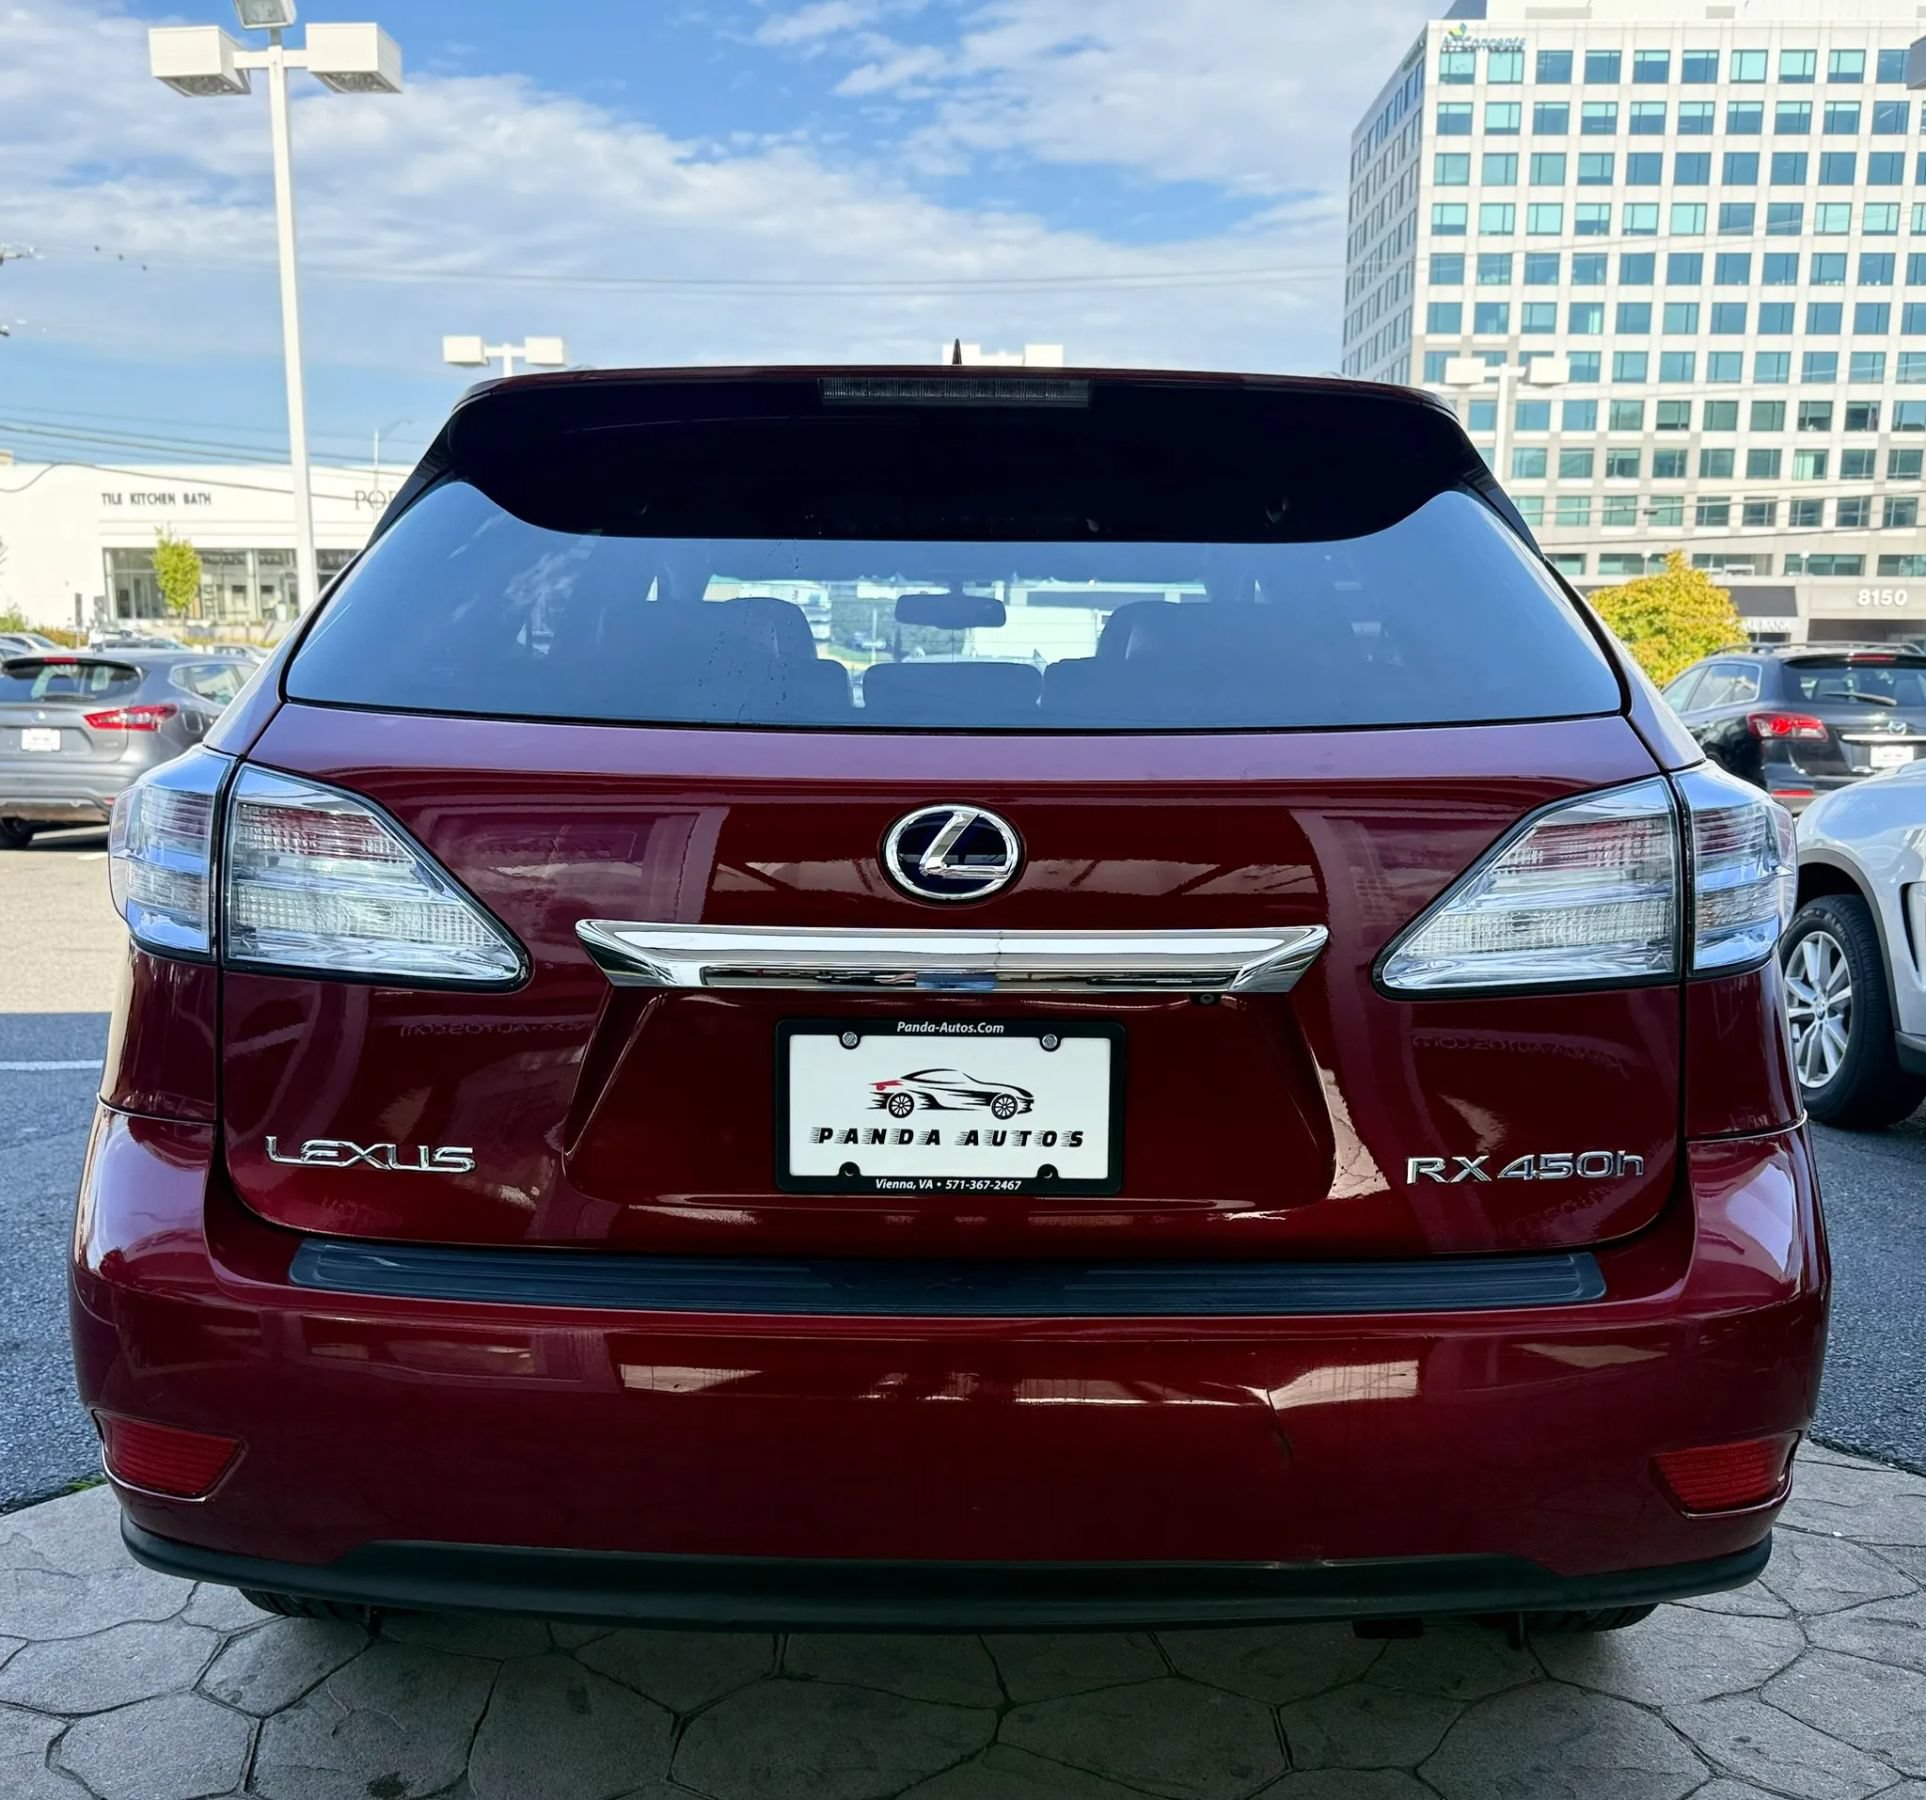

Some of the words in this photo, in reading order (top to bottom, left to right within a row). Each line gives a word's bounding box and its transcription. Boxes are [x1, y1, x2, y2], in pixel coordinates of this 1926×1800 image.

[130, 492, 175, 506] KITCHEN
[183, 492, 212, 505] BATH
[1857, 588, 1908, 606] 8150
[896, 1021, 1005, 1034] Panda-Autos.Com
[808, 1127, 941, 1146] PANDA
[954, 1129, 1084, 1147] AUTOS
[265, 1135, 476, 1173] LEXUS
[1406, 1154, 1493, 1185] RX
[1497, 1149, 1645, 1181] 450h
[875, 1178, 917, 1190] Vienna,
[918, 1178, 934, 1190] VA
[945, 1179, 1022, 1191] 571-367-2467
